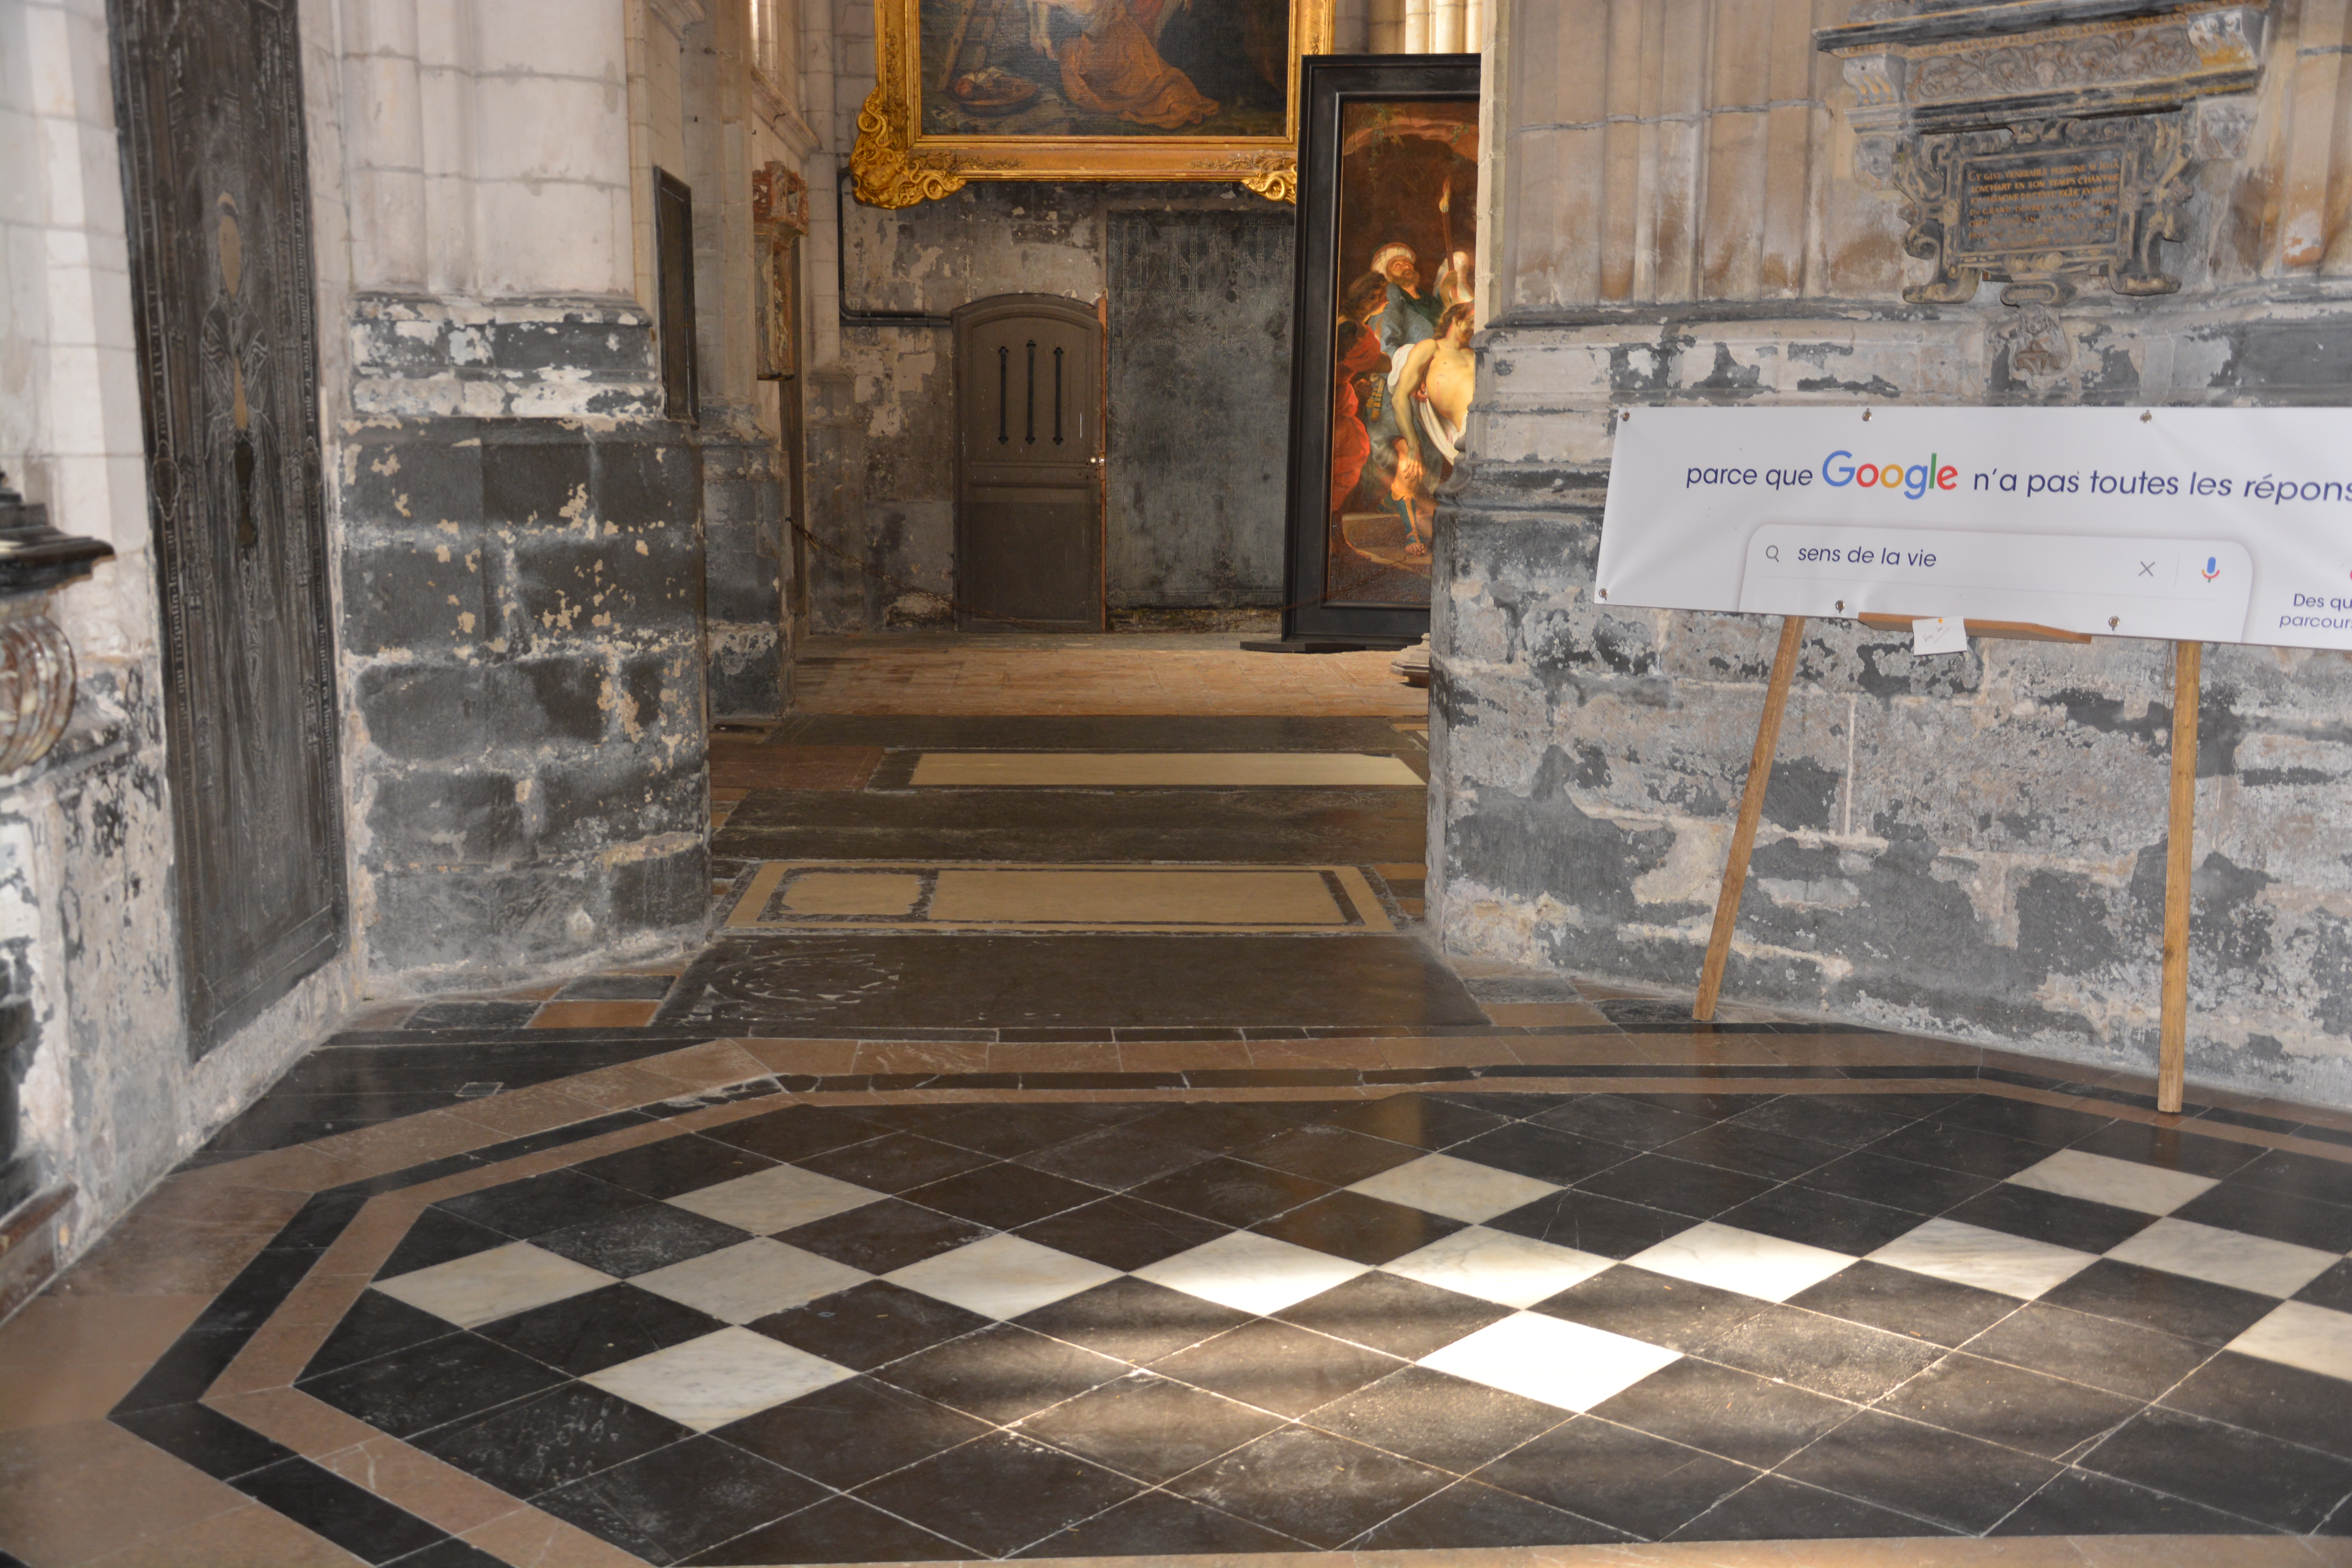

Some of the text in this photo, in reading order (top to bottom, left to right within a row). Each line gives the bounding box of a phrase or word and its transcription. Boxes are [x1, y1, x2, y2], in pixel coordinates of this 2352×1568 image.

[1984, 171, 2002, 181] GIST
[2004, 167, 2047, 179] VENERABLE
[2014, 181, 2025, 189] EN
[2028, 180, 2045, 189] SON
[2048, 177, 2075, 187] TEMPS
[2078, 172, 2119, 185] CHANTRE
[1971, 196, 1981, 205] ET
[1982, 205, 2011, 215] GRAND
[1686, 468, 1758, 489] parce
[1766, 469, 1813, 491] que
[1822, 450, 1959, 500] Google
[2027, 474, 2080, 497] pas
[2090, 470, 2178, 495] toutes
[2190, 471, 2232, 497] les
[2244, 473, 2352, 505] répons
[1798, 546, 1936, 567] sens de la vie
[2293, 593, 2352, 612] Des qu
[2279, 615, 2352, 629] parcour
